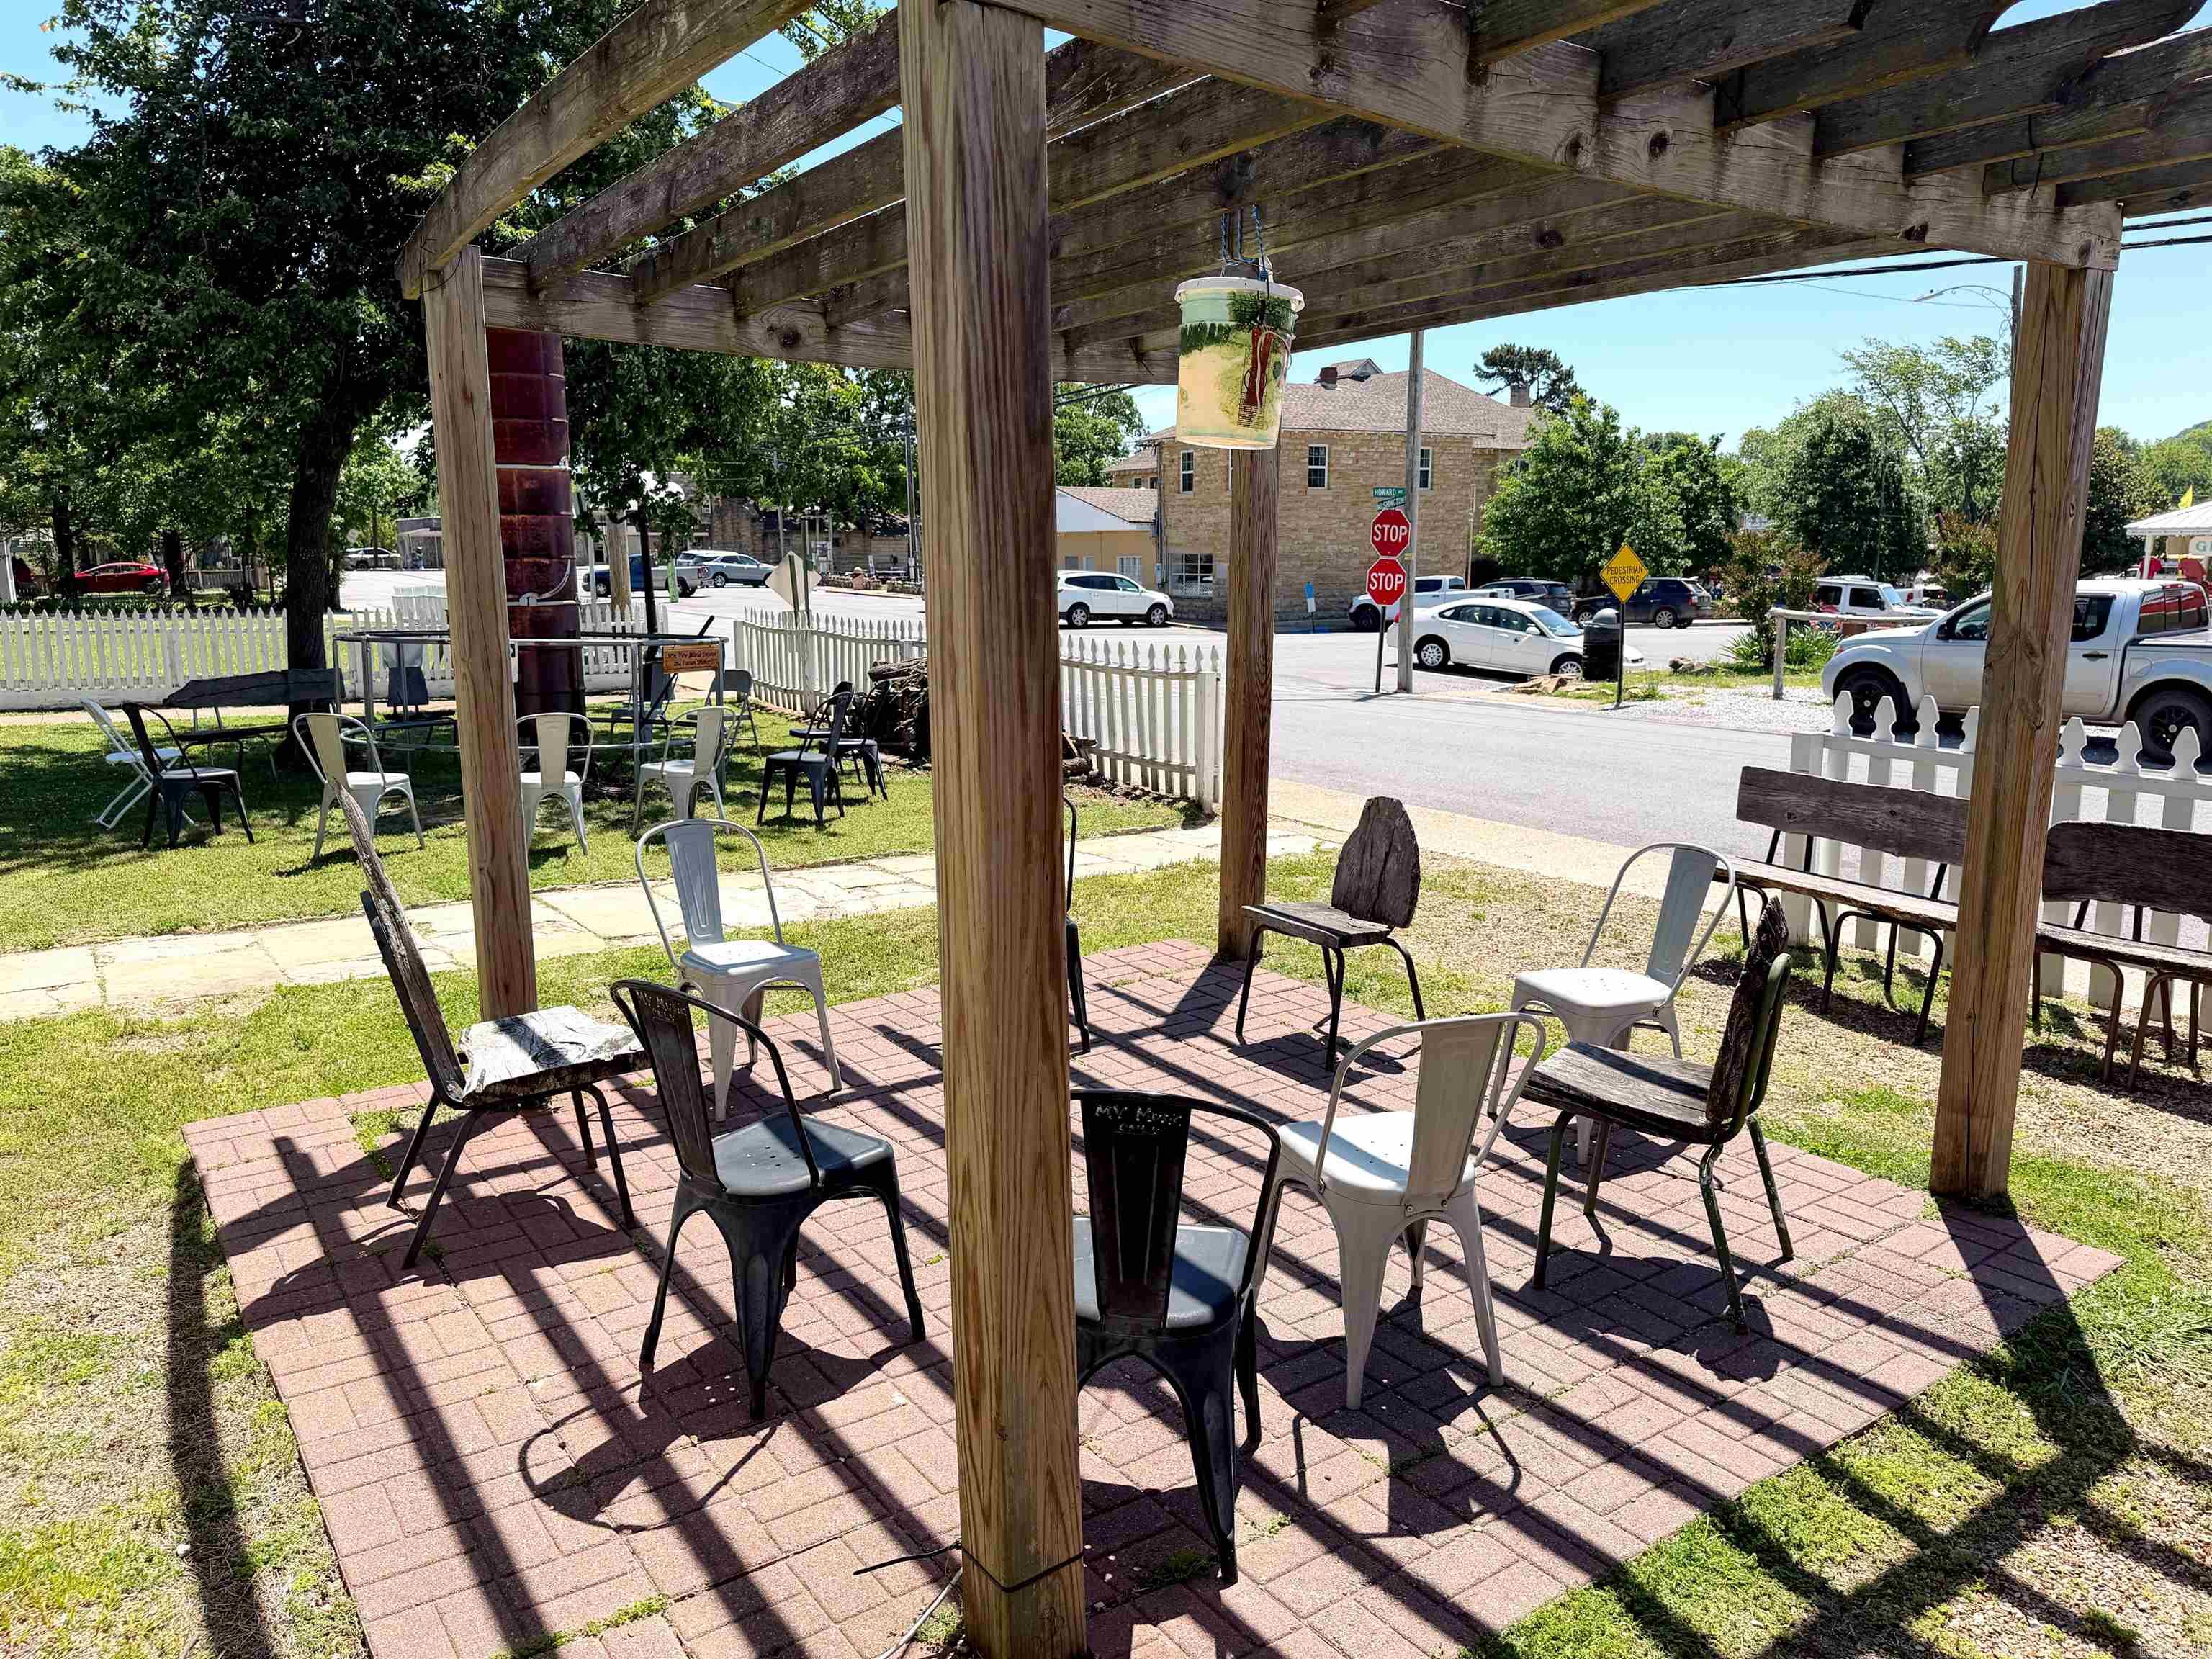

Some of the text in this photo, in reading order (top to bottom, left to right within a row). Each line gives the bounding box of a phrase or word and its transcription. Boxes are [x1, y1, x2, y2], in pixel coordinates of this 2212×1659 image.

[1373, 524, 1408, 542] STOP
[1606, 565, 1642, 575] PEDESTRIAN
[1369, 572, 1403, 591] STOP
[1609, 575, 1640, 585] CROSSING
